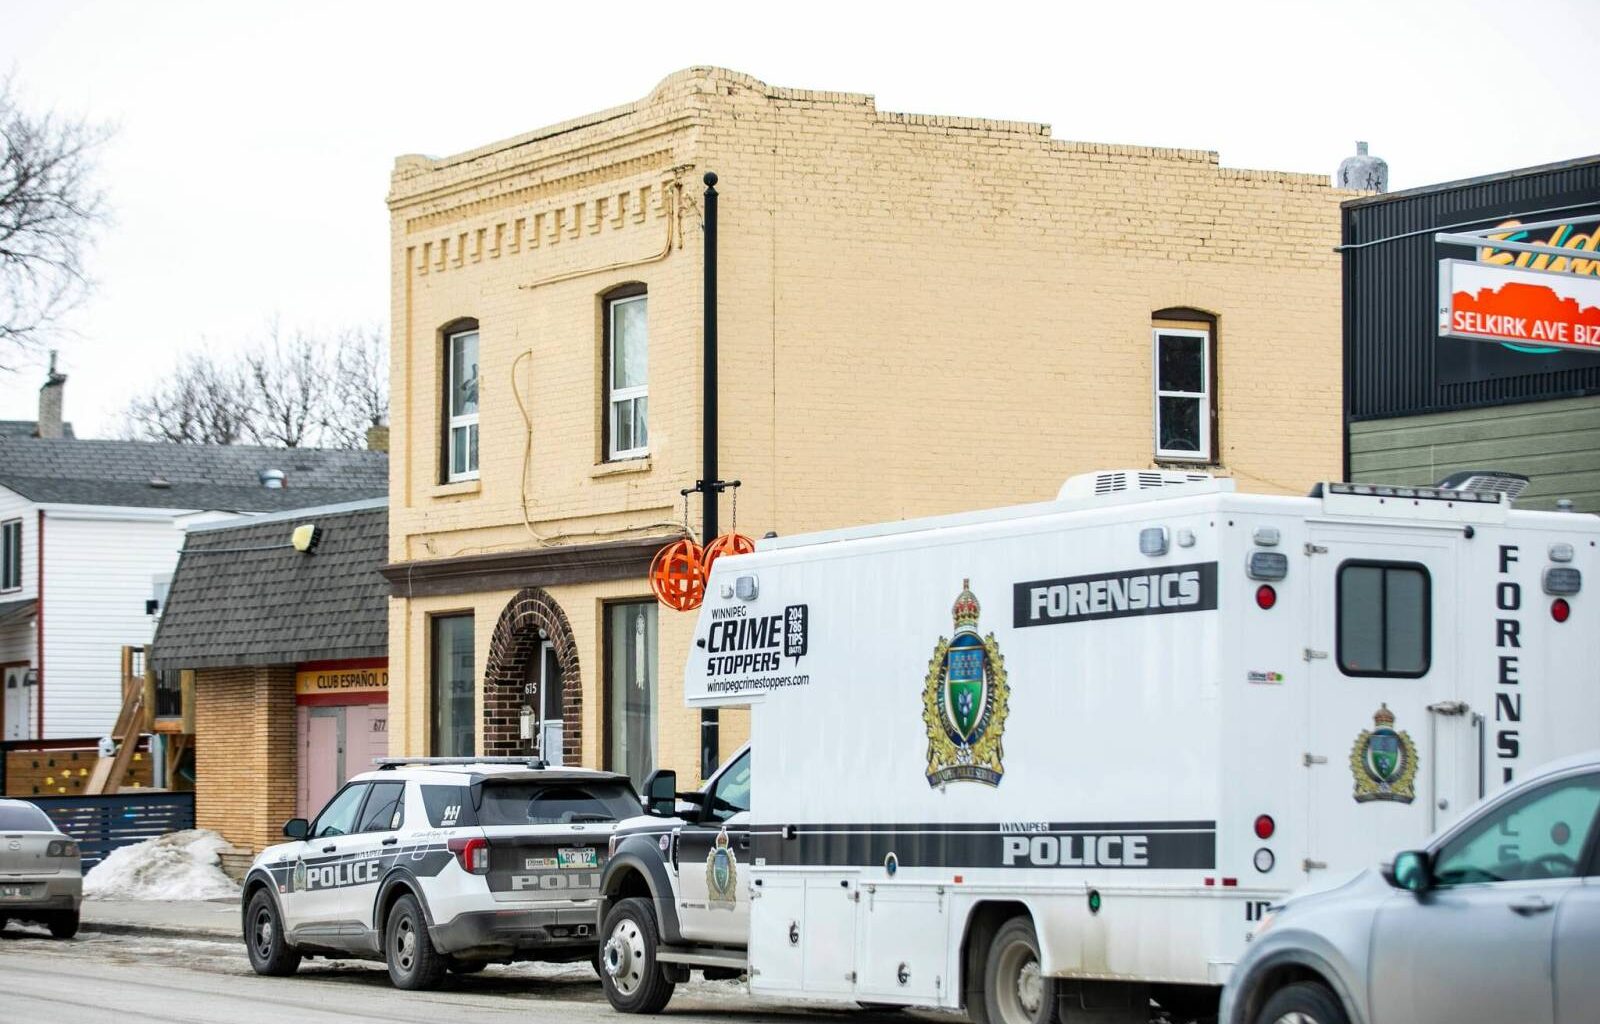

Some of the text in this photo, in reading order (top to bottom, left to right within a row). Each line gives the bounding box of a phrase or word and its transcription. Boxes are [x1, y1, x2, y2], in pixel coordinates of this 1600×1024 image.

[1454, 311, 1527, 337] SELKIRK
[1531, 320, 1569, 342] AVE
[1574, 324, 1600, 344] BIZ
[1029, 571, 1200, 619] FORENSICS
[712, 605, 747, 619] WINNIPEG
[788, 607, 803, 620] 204
[708, 615, 783, 653] CRIME
[788, 620, 803, 633] 786
[787, 632, 803, 646] TIPS
[706, 651, 781, 677] STOPPERS
[317, 671, 389, 688] CLUB ESPAÑOL D
[525, 683, 537, 694] 615
[707, 674, 810, 693] winnipegcrimestoppers.com
[1000, 822, 1048, 832] WINNIPEG
[1002, 835, 1149, 866] POLICE
[307, 860, 379, 889] POLICE
